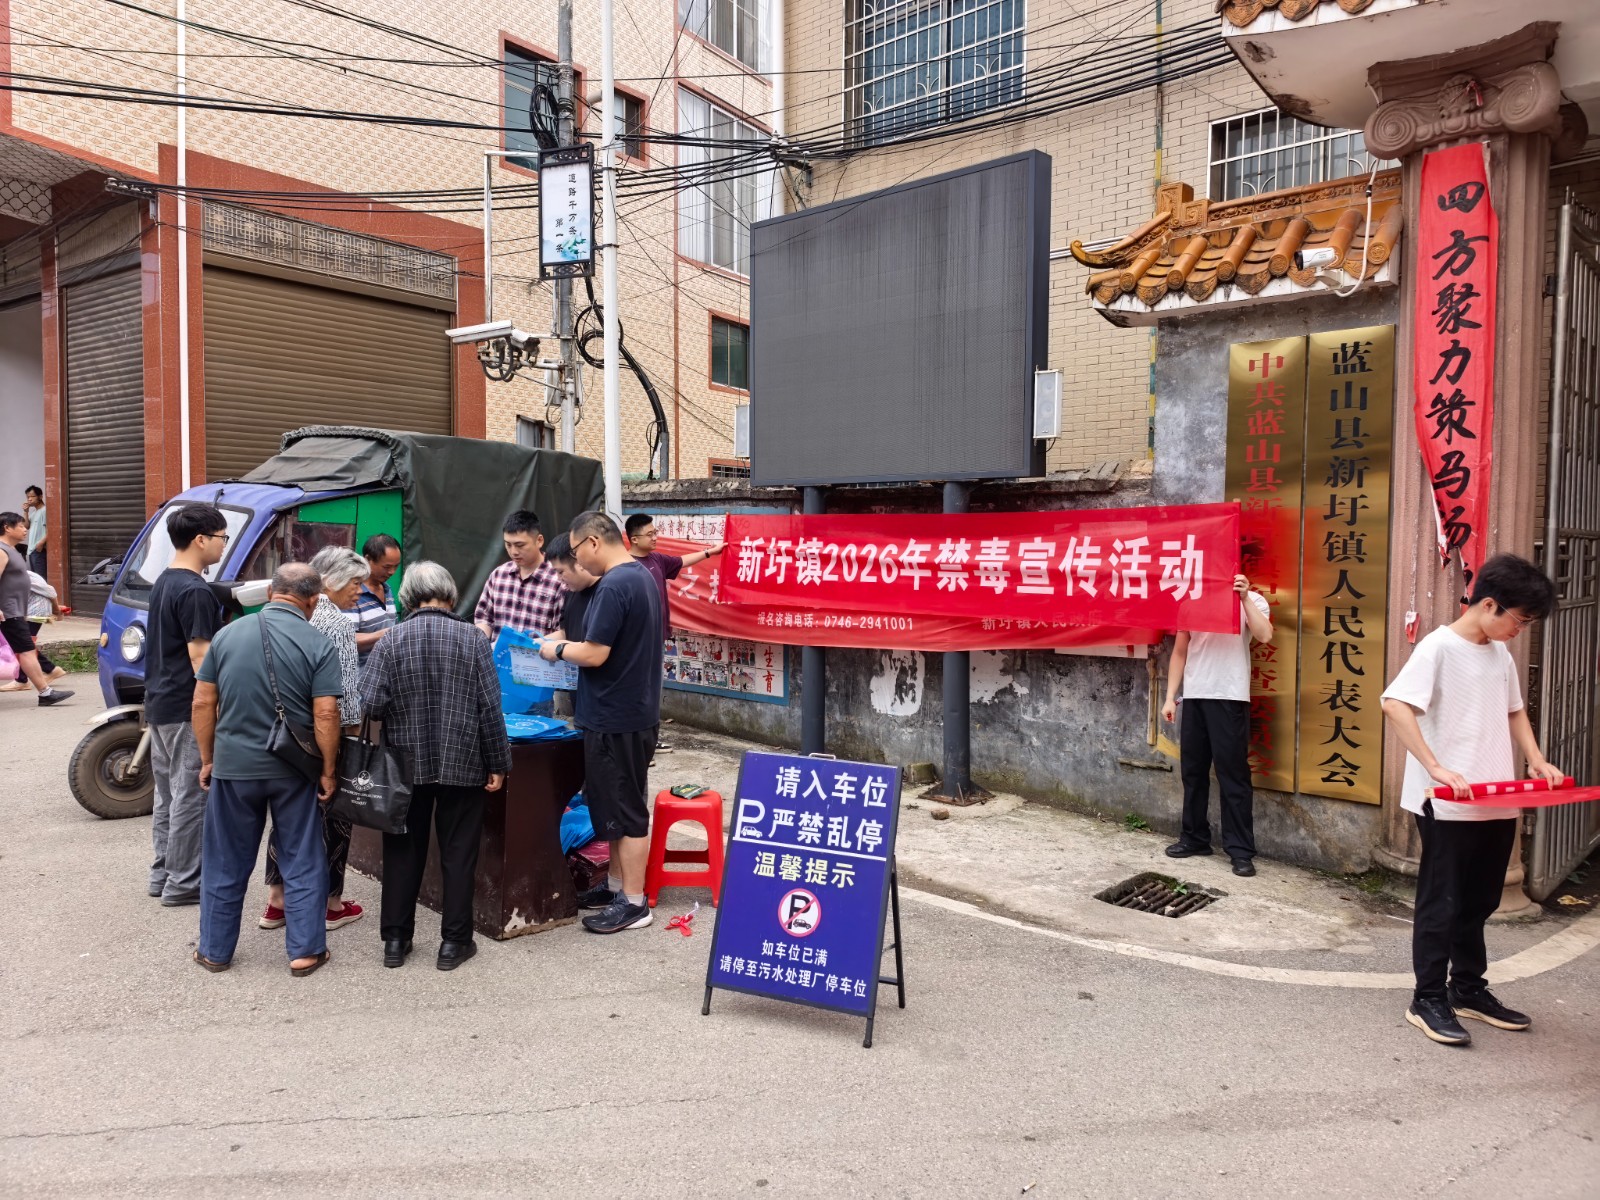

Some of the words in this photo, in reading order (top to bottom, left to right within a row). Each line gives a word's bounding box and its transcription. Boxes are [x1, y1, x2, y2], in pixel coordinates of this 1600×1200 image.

[568, 173, 577, 235] 道路千万条
[555, 217, 564, 254] 第一条
[736, 534, 1205, 602] 新圩镇2026年禁毒宣传活动
[1317, 340, 1373, 788] 蓝山县新圩镇人民代表大会
[762, 645, 775, 694] 生育
[775, 766, 888, 808] 请入车位
[768, 808, 884, 853] 严禁乱停
[752, 850, 856, 889] 温馨提示
[761, 939, 829, 968] 如车位已满
[719, 955, 867, 998] 请停至污水处理厂停车位
